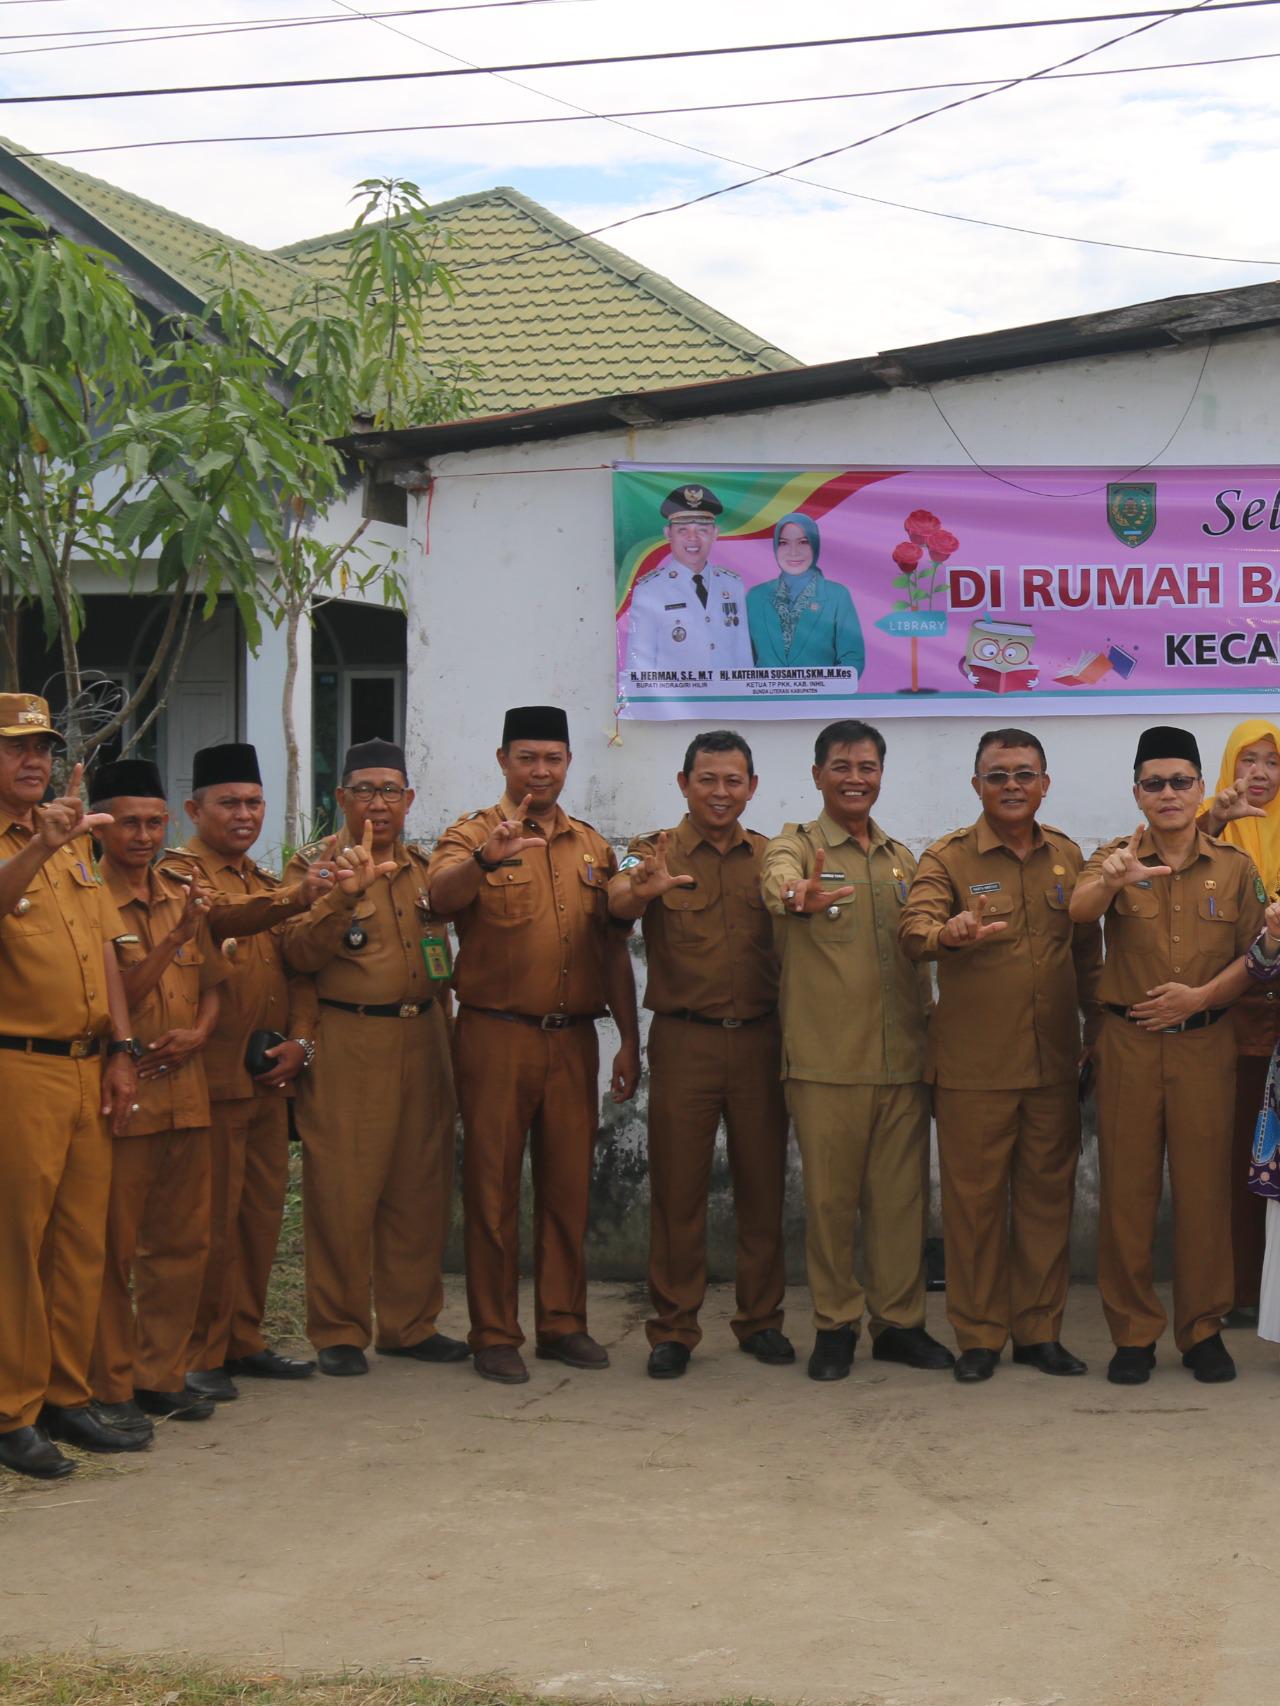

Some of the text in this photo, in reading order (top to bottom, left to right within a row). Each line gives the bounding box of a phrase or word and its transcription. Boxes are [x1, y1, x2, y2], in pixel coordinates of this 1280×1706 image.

[948, 567, 1003, 610] DI
[1022, 564, 1222, 611] RUMAH
[888, 620, 946, 633] LIBRARY
[630, 671, 639, 681] H.
[640, 671, 680, 682] HERMAN,
[699, 670, 714, 681] M.T
[720, 670, 731, 681] Hj.
[731, 669, 769, 680] KATERINA
